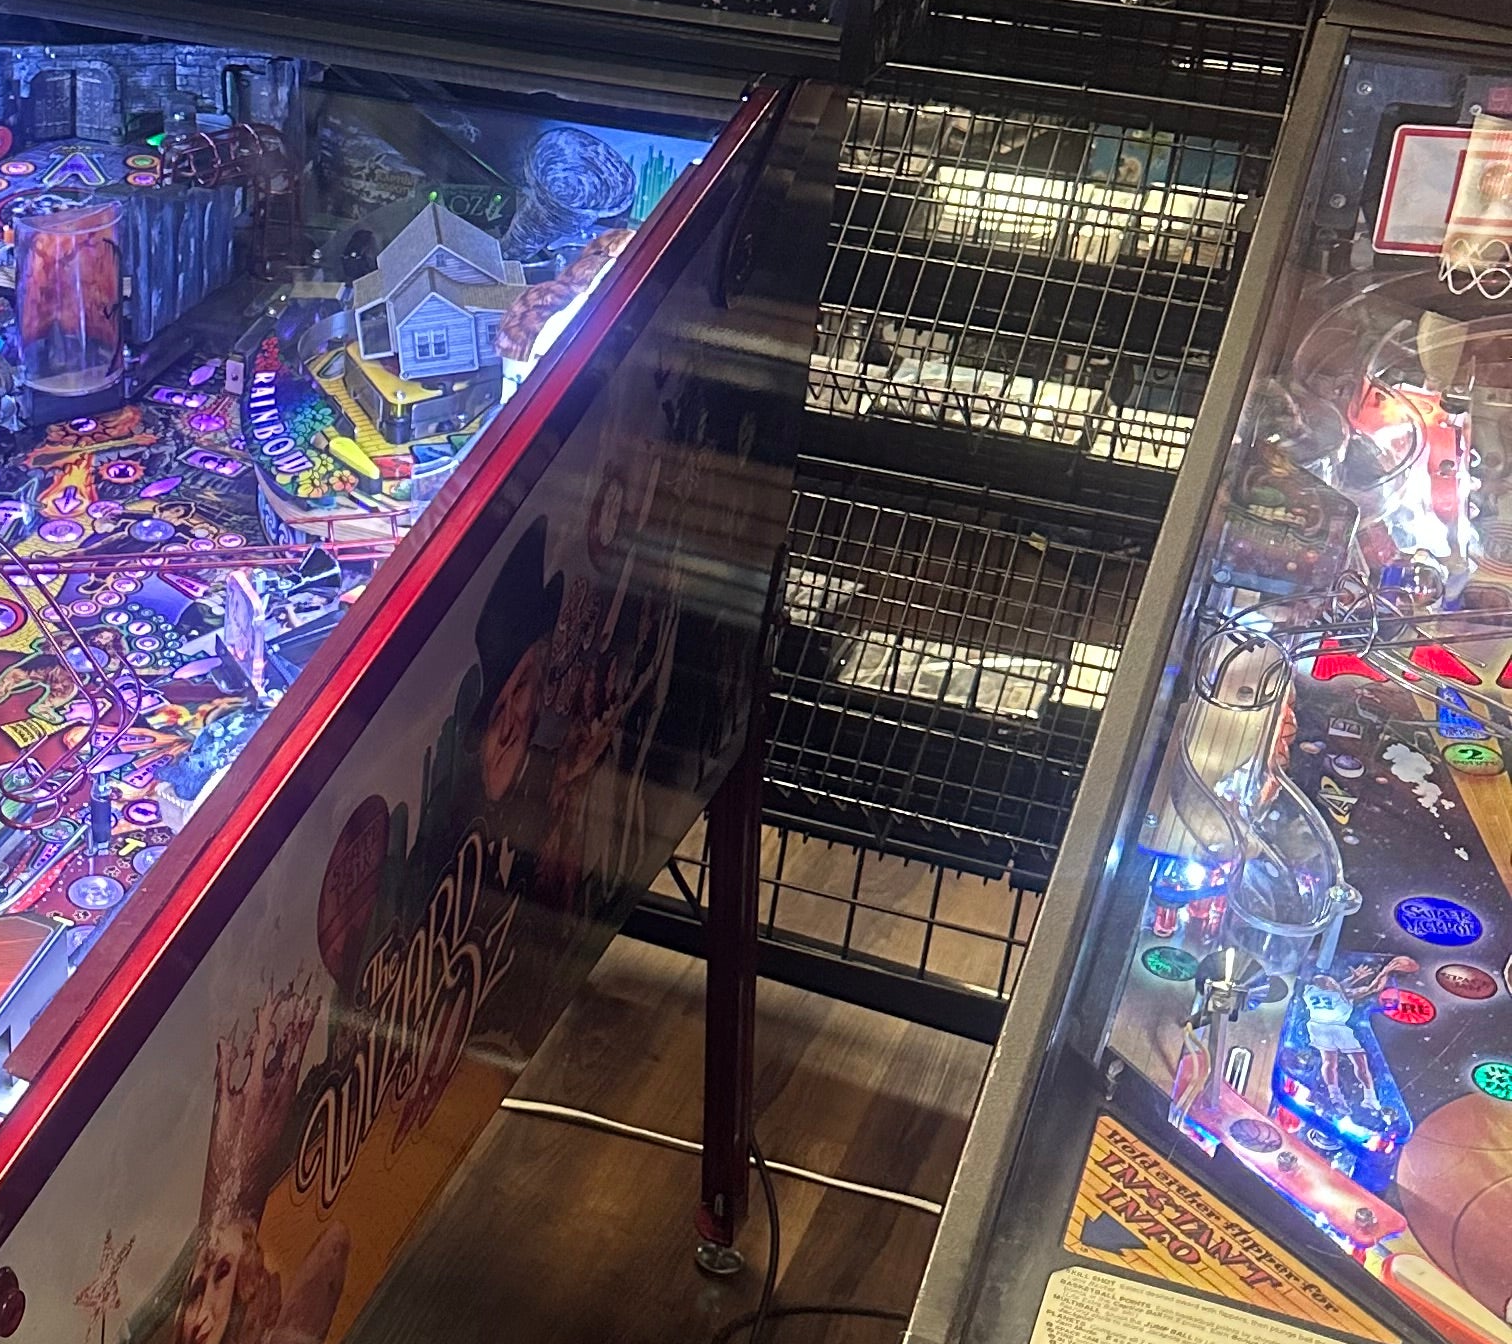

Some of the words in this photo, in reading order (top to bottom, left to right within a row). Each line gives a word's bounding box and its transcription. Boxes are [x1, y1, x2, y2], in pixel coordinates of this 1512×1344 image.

[249, 370, 314, 476] RAINBOW
[1458, 749, 1483, 760] 2
[1402, 904, 1472, 923] SUPER
[1403, 917, 1477, 937] JACKPOT
[363, 931, 402, 1007] The
[295, 830, 484, 1209] WIZARD
[1096, 1149, 1284, 1290] INSTANT
[1096, 1182, 1201, 1265] INFO
[1105, 1129, 1155, 1171] Hold
[1222, 1219, 1300, 1284] flipper
[1302, 1278, 1339, 1314] for
